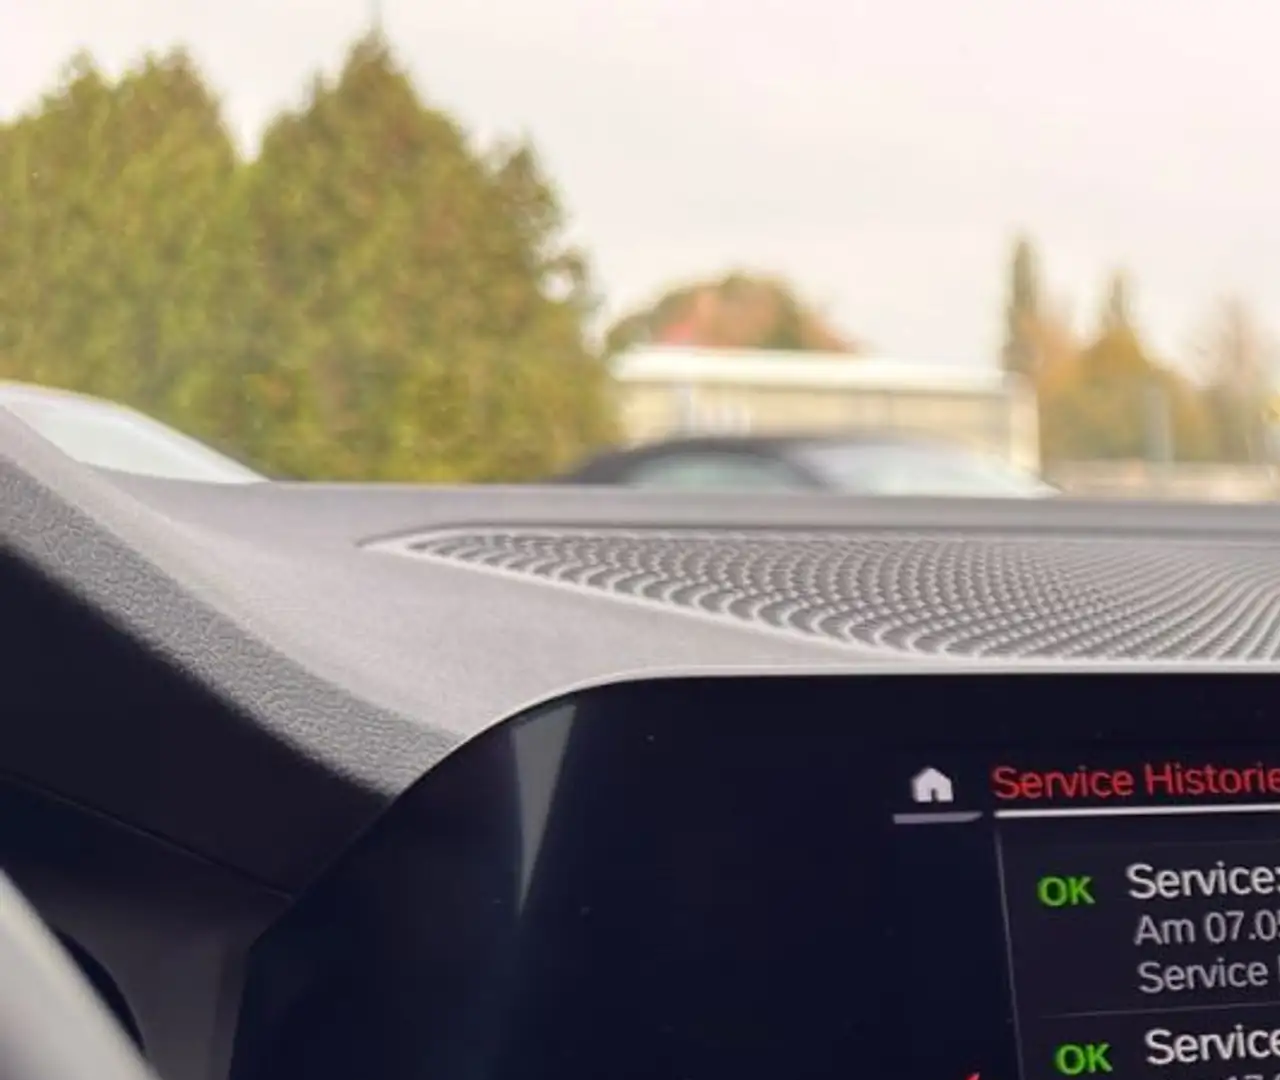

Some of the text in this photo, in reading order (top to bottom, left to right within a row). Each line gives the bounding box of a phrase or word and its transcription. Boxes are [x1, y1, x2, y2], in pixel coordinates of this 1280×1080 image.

[992, 766, 1133, 799] Service
[1038, 876, 1094, 906] OK
[1135, 914, 1195, 946] Am
[1138, 957, 1268, 994] Service
[1055, 1043, 1112, 1075] OK
